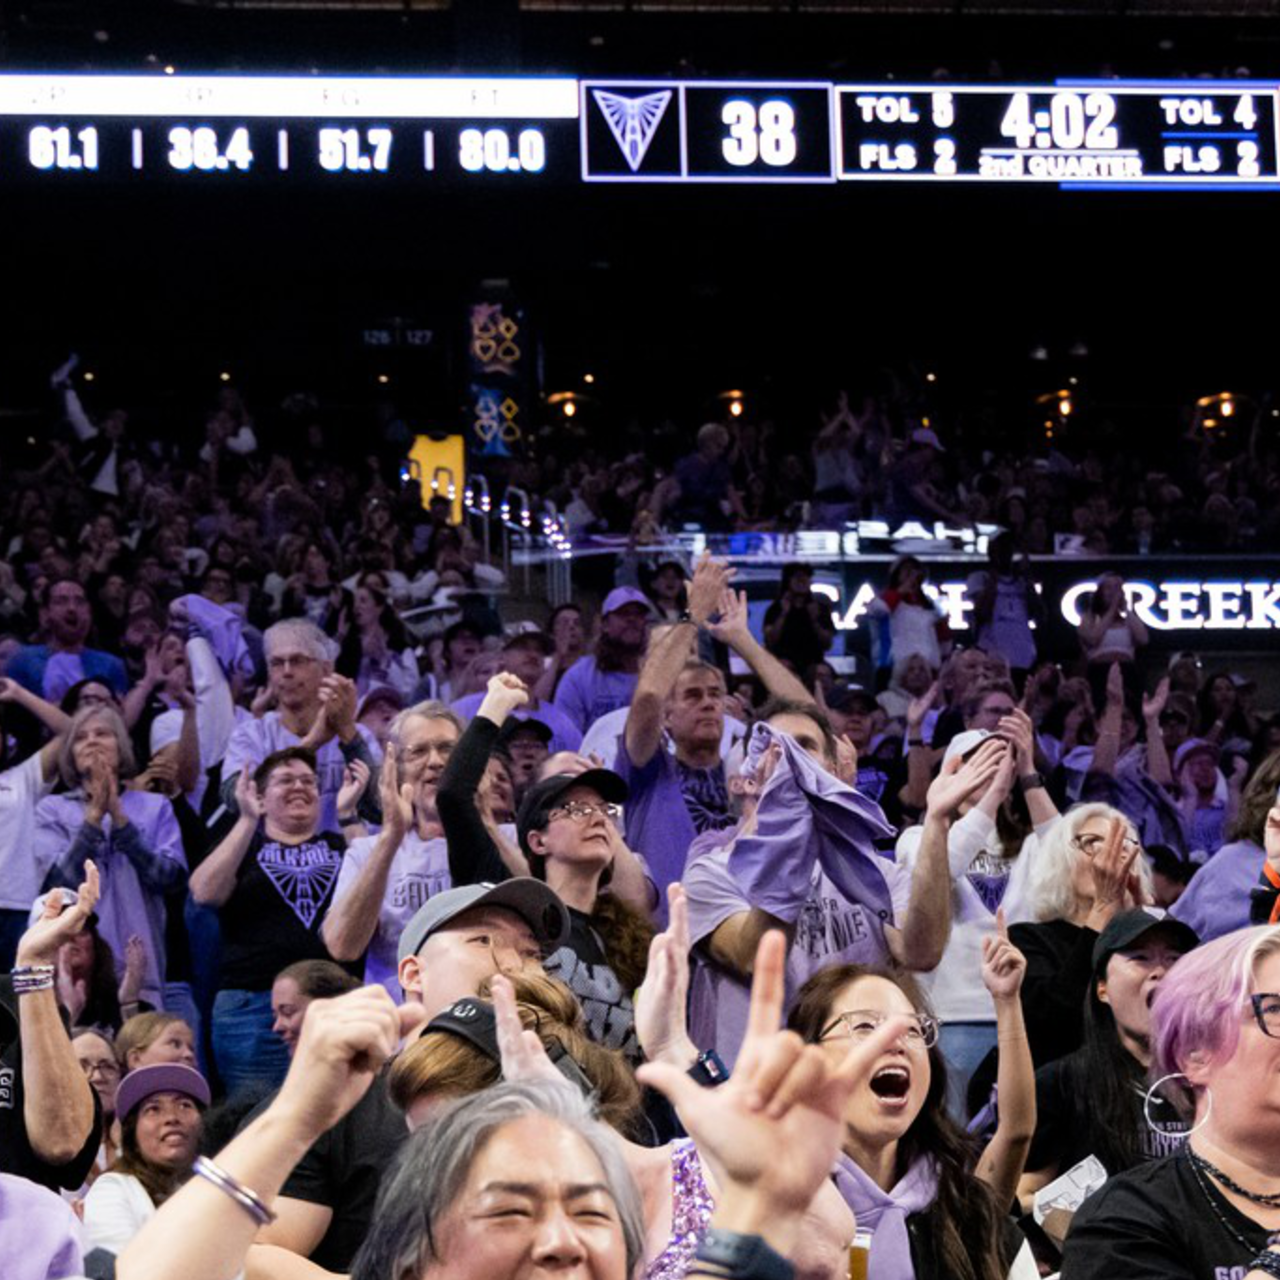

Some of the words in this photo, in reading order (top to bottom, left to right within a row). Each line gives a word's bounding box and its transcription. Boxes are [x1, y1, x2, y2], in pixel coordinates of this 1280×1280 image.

[856, 96, 919, 123] TOL
[931, 92, 954, 128] 5
[1000, 91, 1122, 150] 4:02
[1159, 98, 1222, 125] TOL
[1231, 93, 1260, 130] 4
[721, 100, 796, 166] 38
[859, 144, 917, 170] FLS
[931, 139, 960, 176] 2
[979, 155, 1022, 177] 2nd
[1028, 155, 1143, 178] QUARTER
[1163, 146, 1221, 172] FLS
[1234, 140, 1264, 179] 2
